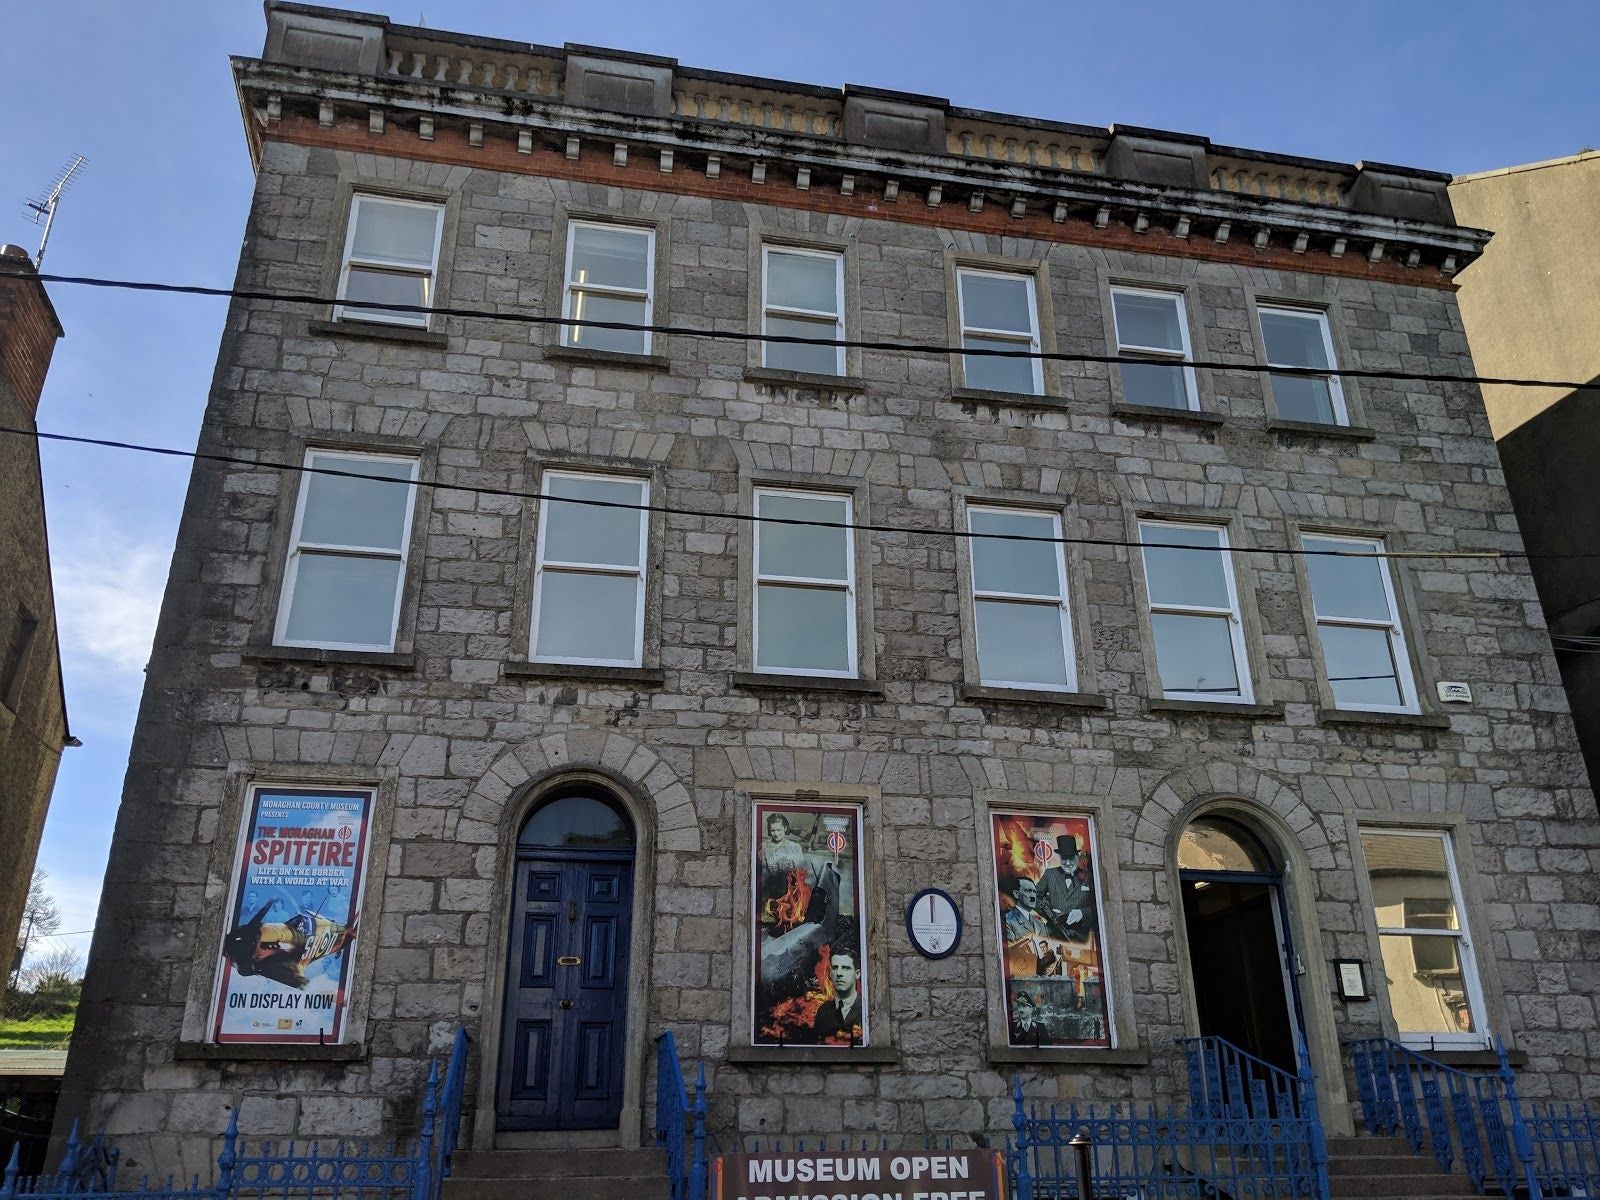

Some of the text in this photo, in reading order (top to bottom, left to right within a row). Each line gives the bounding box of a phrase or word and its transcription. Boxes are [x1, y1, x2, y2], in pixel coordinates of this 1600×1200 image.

[262, 800, 360, 812] MONAGHAN COUNTY MUSEUM
[260, 811, 289, 819] PRESENTS
[258, 826, 336, 840] THE MONAGHAN
[253, 839, 356, 867] SPITFIRE
[258, 867, 345, 877] LIFE ON THE BORDER
[251, 876, 350, 887] WITH A WORLD AT WAR
[229, 992, 335, 1010] ON DISPLAY NOW
[748, 1155, 969, 1183] MUSEUM OPEN
